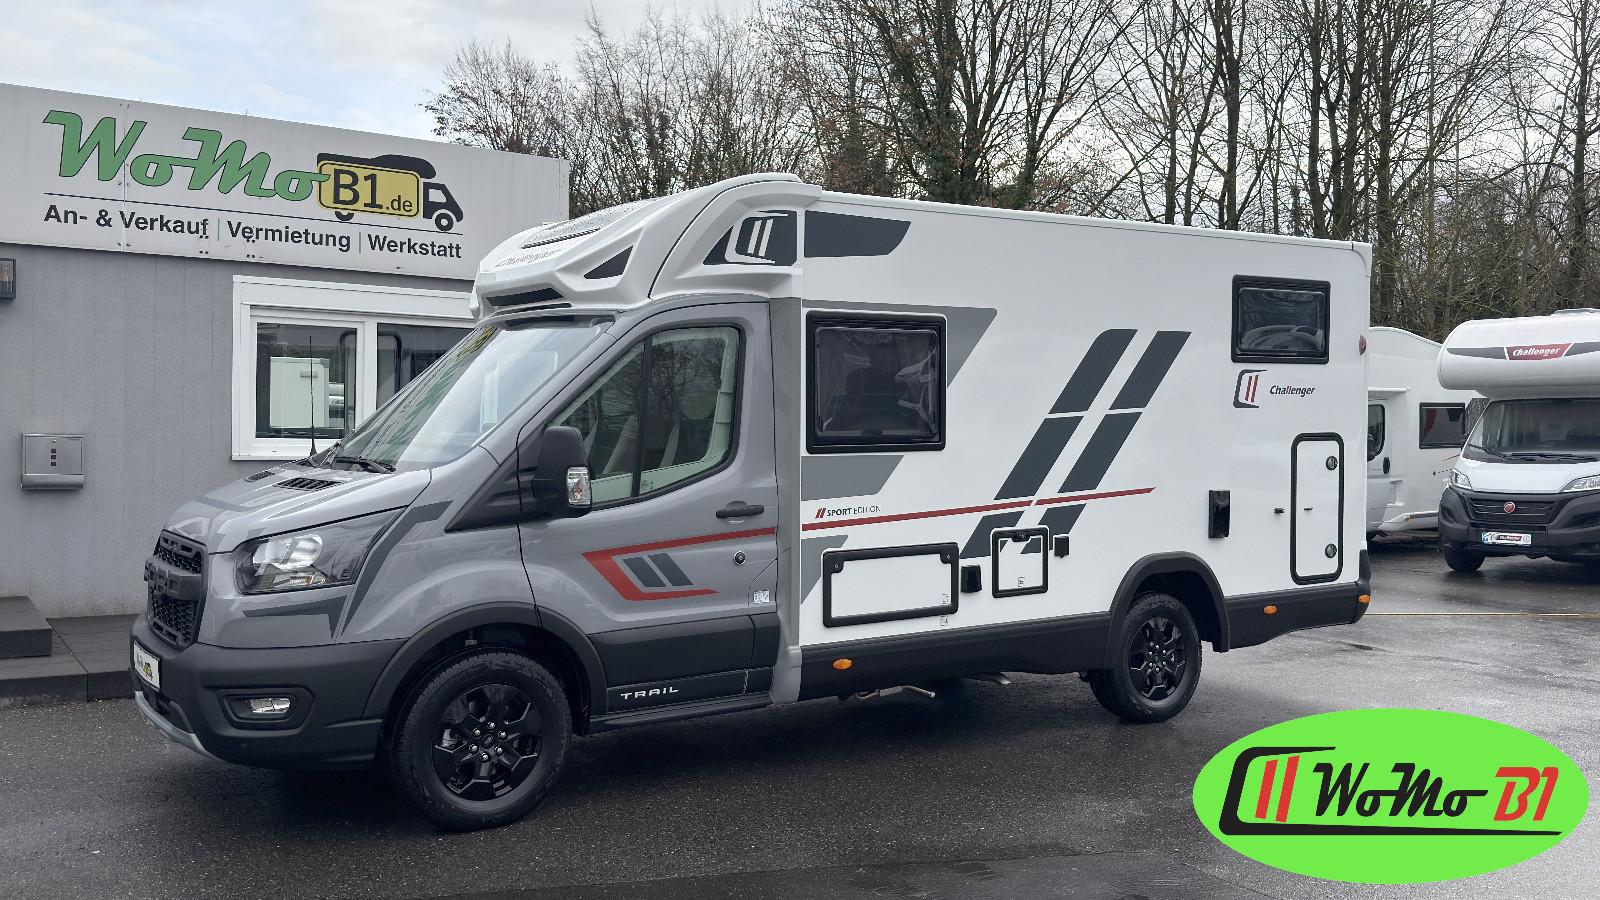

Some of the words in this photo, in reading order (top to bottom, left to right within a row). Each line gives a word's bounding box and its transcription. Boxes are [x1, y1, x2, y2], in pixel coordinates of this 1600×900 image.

[42, 110, 331, 201] WoMo
[44, 204, 88, 225] An-
[96, 208, 113, 228] &
[119, 210, 209, 236] Verkauf
[227, 220, 351, 253] Vermietung
[367, 233, 462, 259] Werkstatt
[1512, 347, 1561, 357] Challenger
[1269, 385, 1316, 397] Challenger
[827, 507, 853, 517] SPORT
[620, 686, 680, 700] TRAIL
